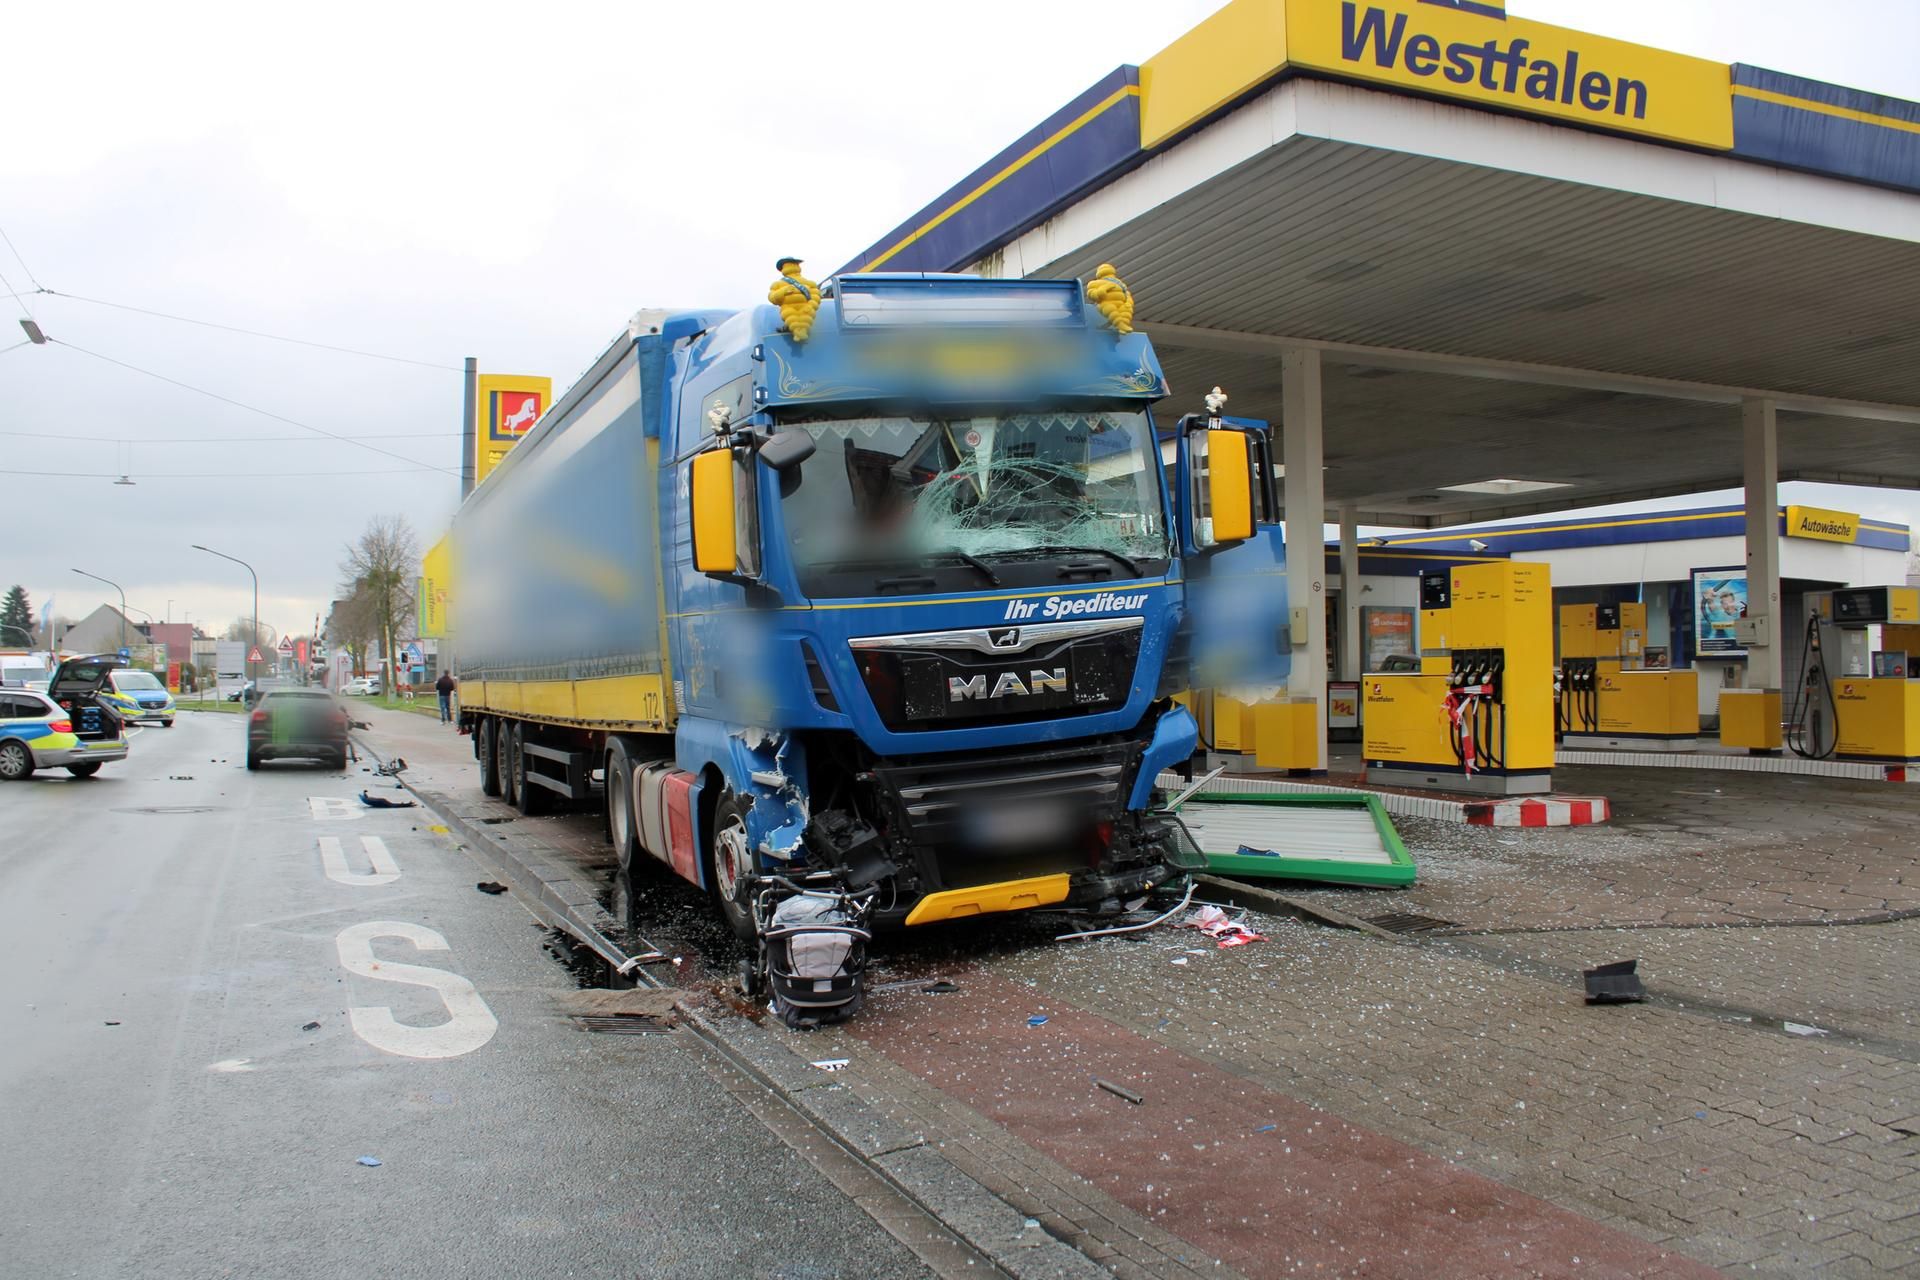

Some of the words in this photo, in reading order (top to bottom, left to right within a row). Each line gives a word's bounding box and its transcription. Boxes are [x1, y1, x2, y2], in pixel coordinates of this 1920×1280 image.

[1341, 1, 1648, 120] Westfalen
[1800, 516, 1852, 537] Autowäsche
[1003, 599, 1040, 620] Ihr
[1042, 592, 1149, 620] Spediteur
[948, 667, 1067, 702] MAN
[643, 692, 660, 719] 172
[1367, 695, 1395, 703] Westfalen
[308, 796, 498, 1059] BUS
